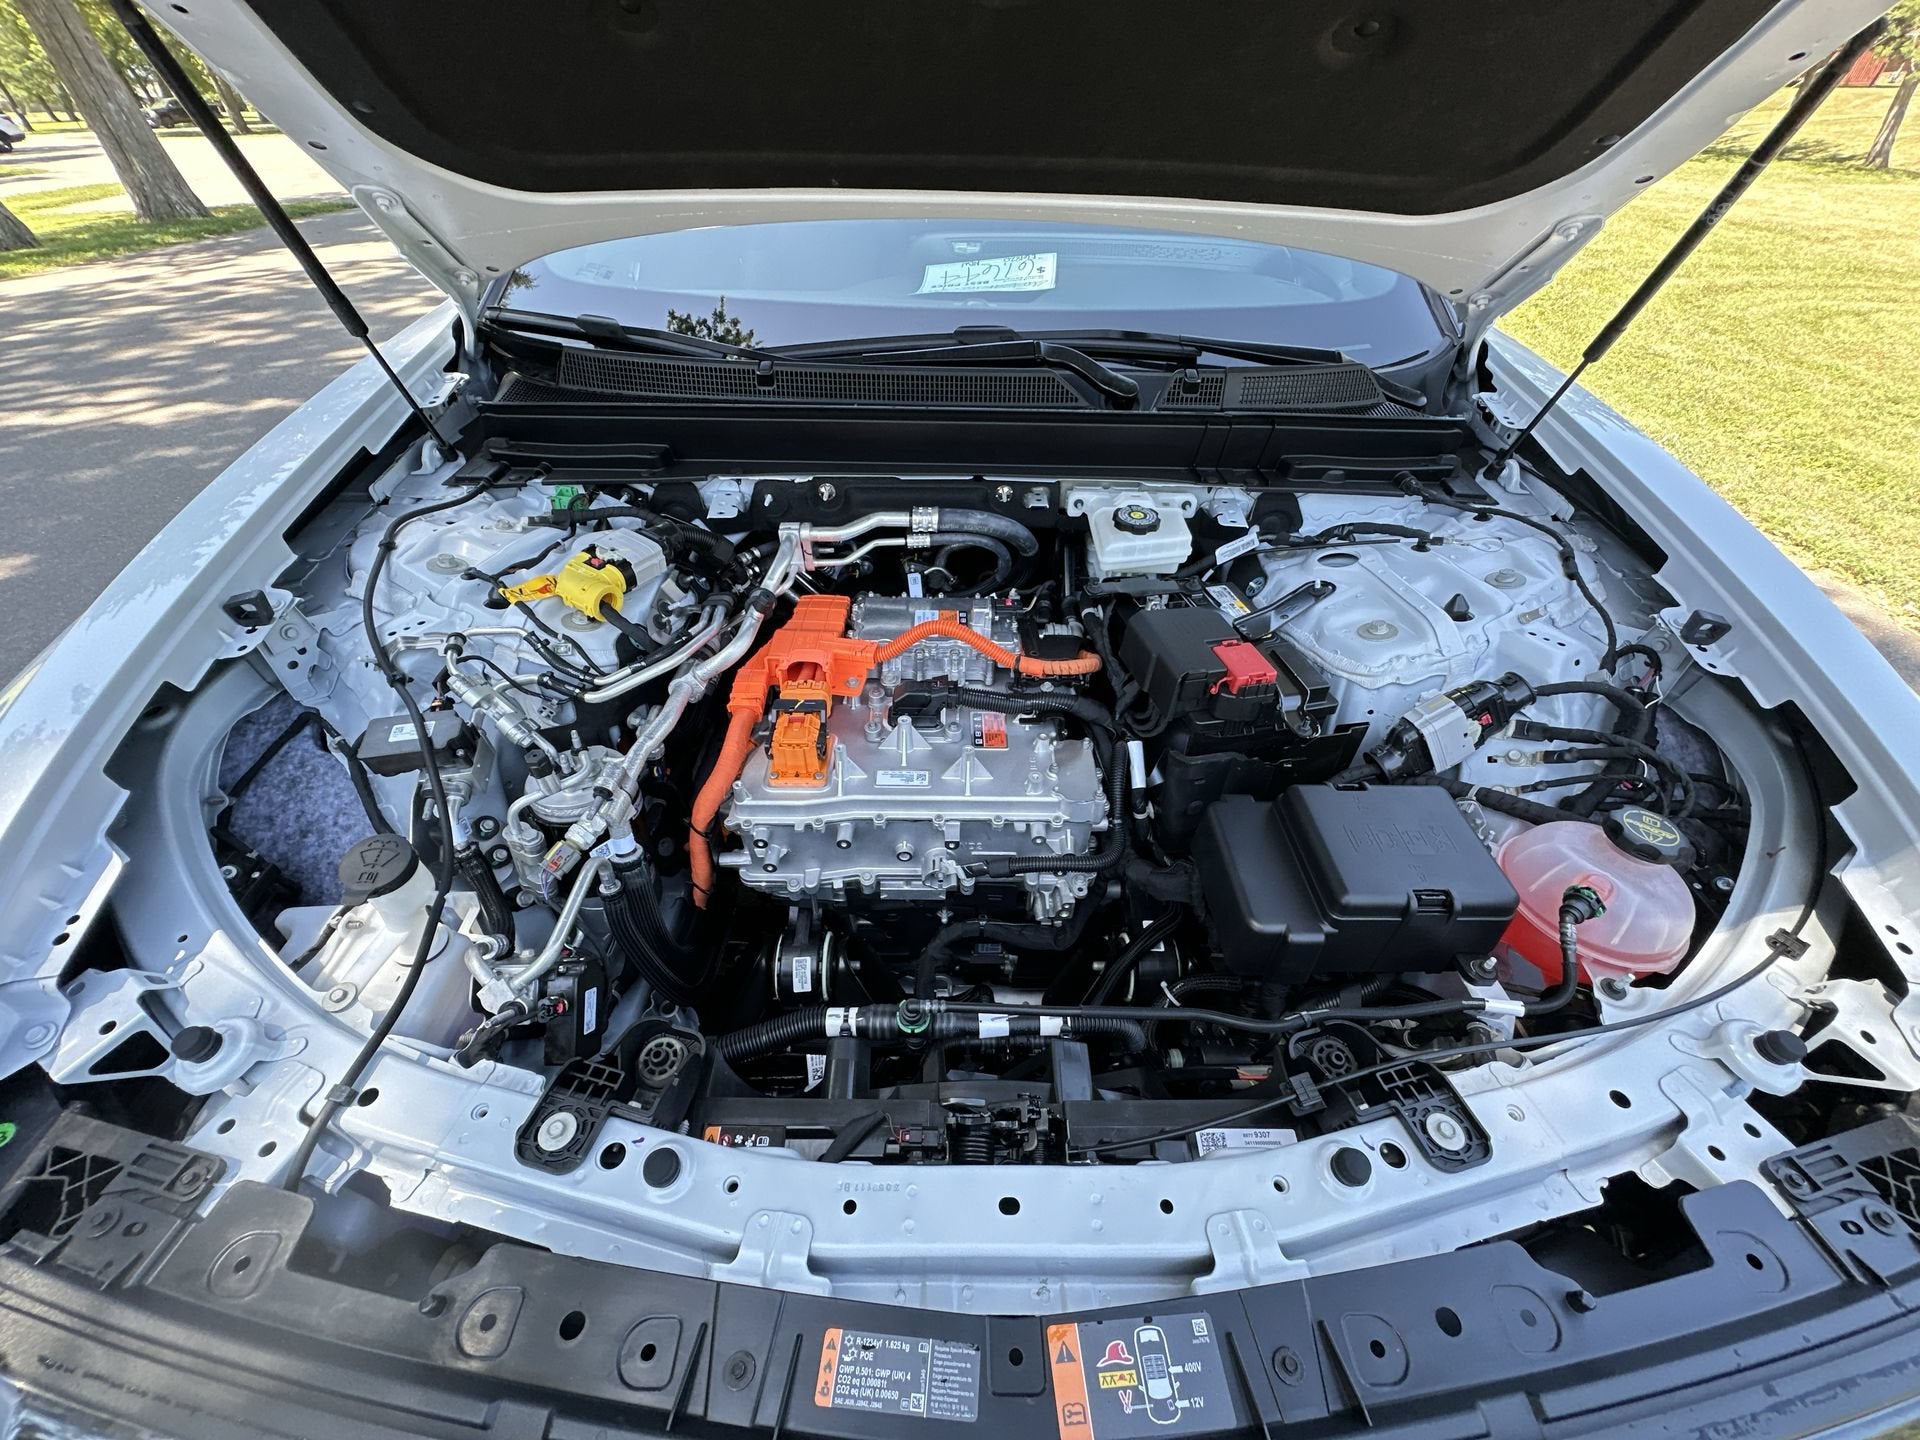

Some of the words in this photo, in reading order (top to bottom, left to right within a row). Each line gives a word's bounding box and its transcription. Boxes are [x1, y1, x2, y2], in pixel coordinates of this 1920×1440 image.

[856, 1336, 883, 1349] R-1234yf
[885, 1340, 901, 1350] 1.625
[901, 1341, 910, 1352] kg
[859, 1351, 874, 1361] POE
[839, 1364, 854, 1374] GWP
[875, 1368, 891, 1378] GWP
[891, 1370, 905, 1382] (UK)
[906, 1371, 911, 1381] 4
[1184, 1361, 1202, 1374] 400V
[837, 1374, 851, 1384] CO2
[852, 1377, 861, 1387] eq
[836, 1384, 850, 1394] CO2
[850, 1387, 859, 1397] eq
[859, 1388, 874, 1399] (UK)
[1190, 1396, 1204, 1408] 12V
